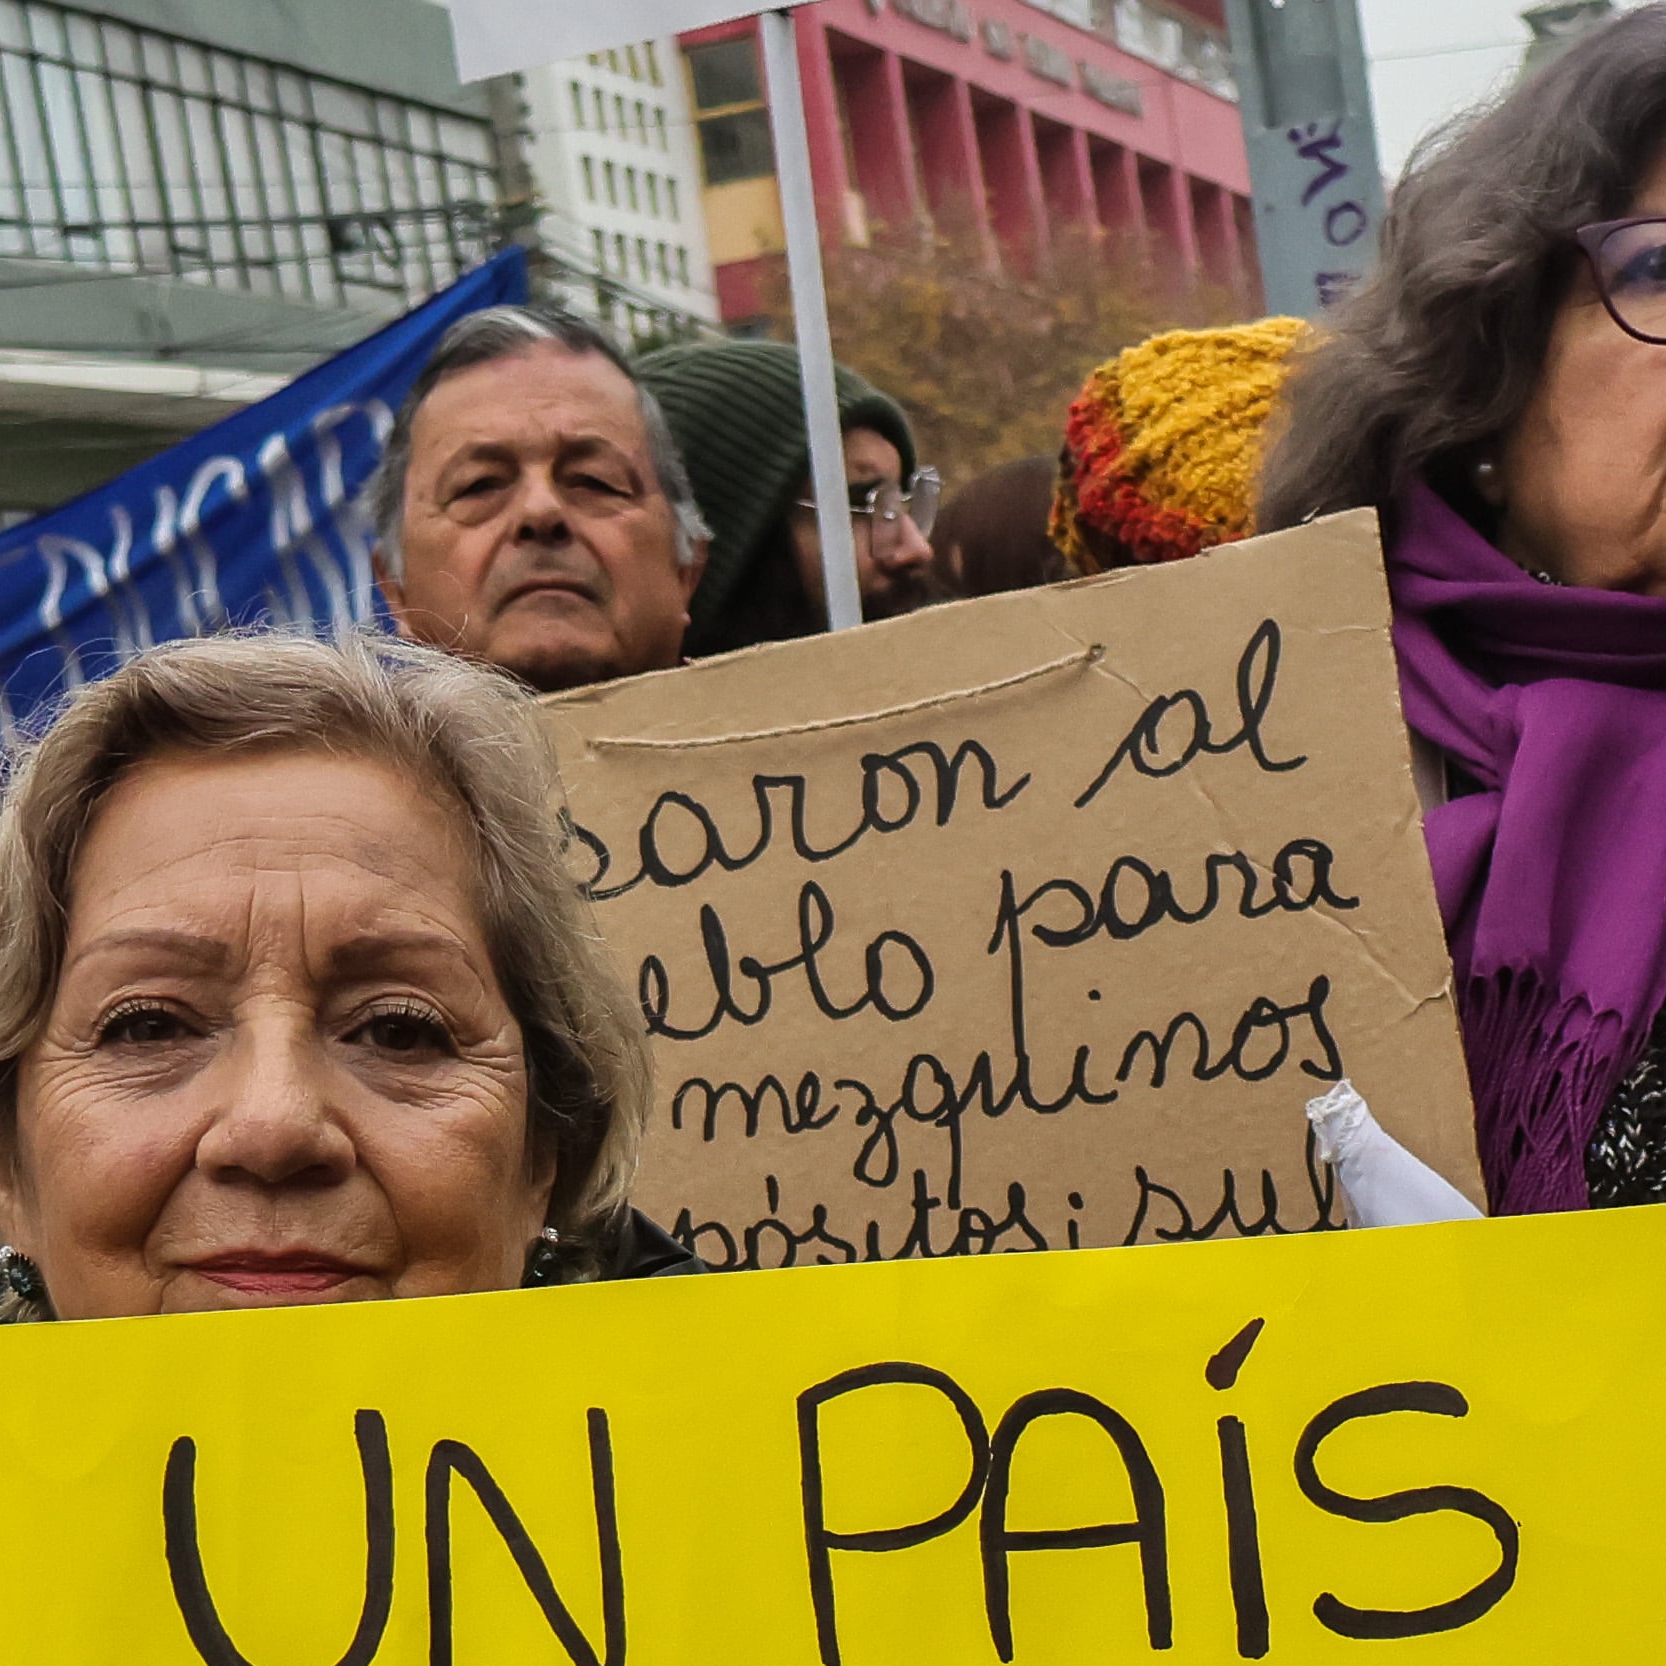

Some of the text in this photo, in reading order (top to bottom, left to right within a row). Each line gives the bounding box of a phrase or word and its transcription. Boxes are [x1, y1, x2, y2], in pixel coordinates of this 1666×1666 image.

[1075, 620, 1307, 808] al
[988, 838, 1361, 1080] para
[673, 975, 1343, 1210] mezquinos
